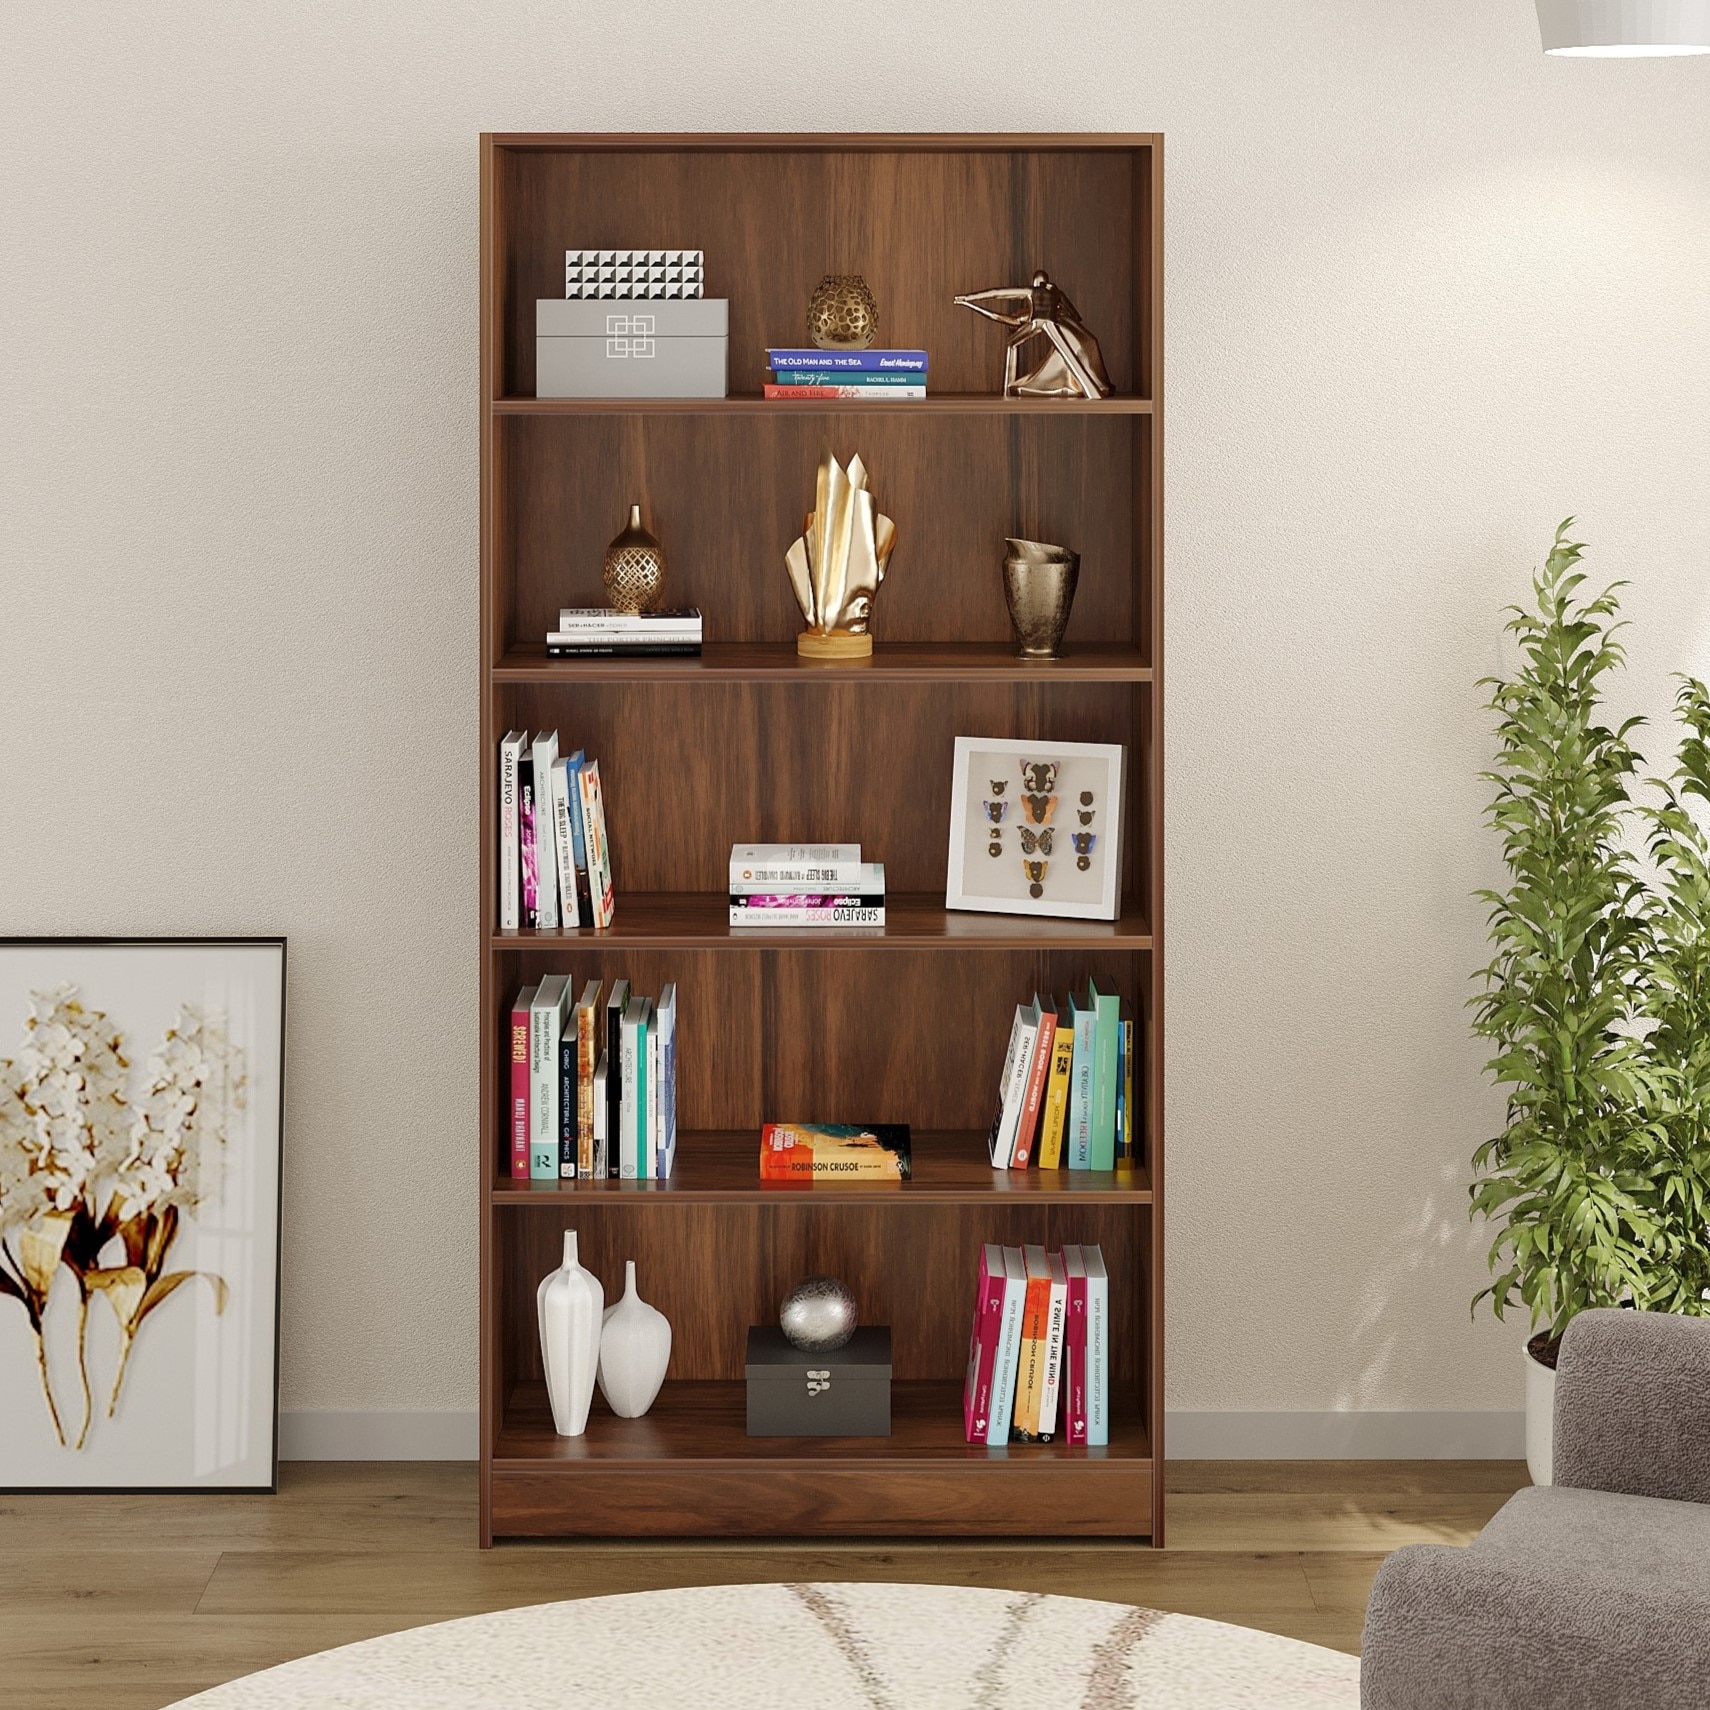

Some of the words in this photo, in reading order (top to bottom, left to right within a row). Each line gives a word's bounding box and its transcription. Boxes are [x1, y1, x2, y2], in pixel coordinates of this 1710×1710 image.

[774, 358, 788, 366] THE
[788, 358, 802, 366] OLD
[803, 358, 819, 366] MAN
[504, 751, 513, 805] SARAJEVO
[504, 807, 513, 838] ROSES
[559, 820, 567, 838] SLEEP
[806, 869, 821, 881] SLEEP
[806, 908, 831, 921] ROSES
[833, 908, 878, 921] SARAJEVO
[513, 1026, 527, 1064] SCREWED!
[792, 1162, 828, 1171] ROBINSON
[830, 1162, 859, 1171] CRUSOE
